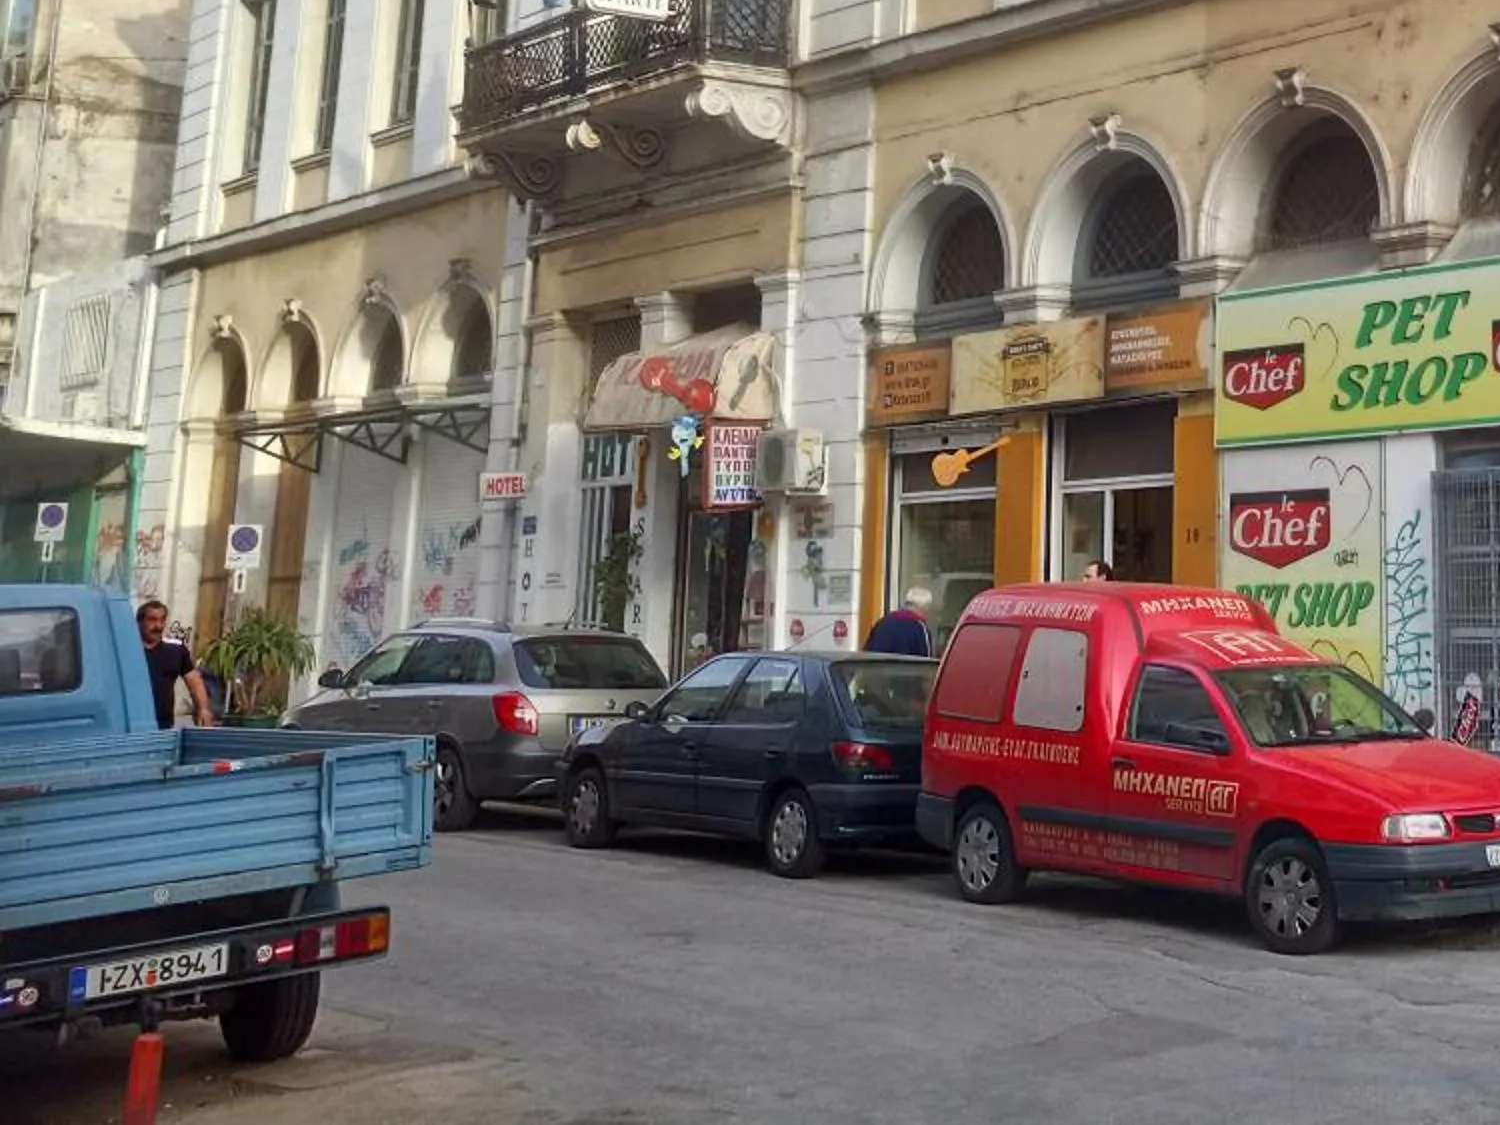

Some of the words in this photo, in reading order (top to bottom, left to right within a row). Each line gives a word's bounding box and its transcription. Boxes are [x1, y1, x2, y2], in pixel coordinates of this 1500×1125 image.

[1353, 290, 1471, 349] PET
[1225, 356, 1303, 398] Chef
[1330, 352, 1488, 413] SHOP
[487, 477, 525, 495] HOTEL
[1233, 506, 1328, 549] Chef
[631, 516, 645, 625] SPAR
[1288, 580, 1375, 628] SHOP
[1113, 770, 1206, 799] ΜΗΧΑΝΕΠ
[159, 946, 223, 981] 8941
